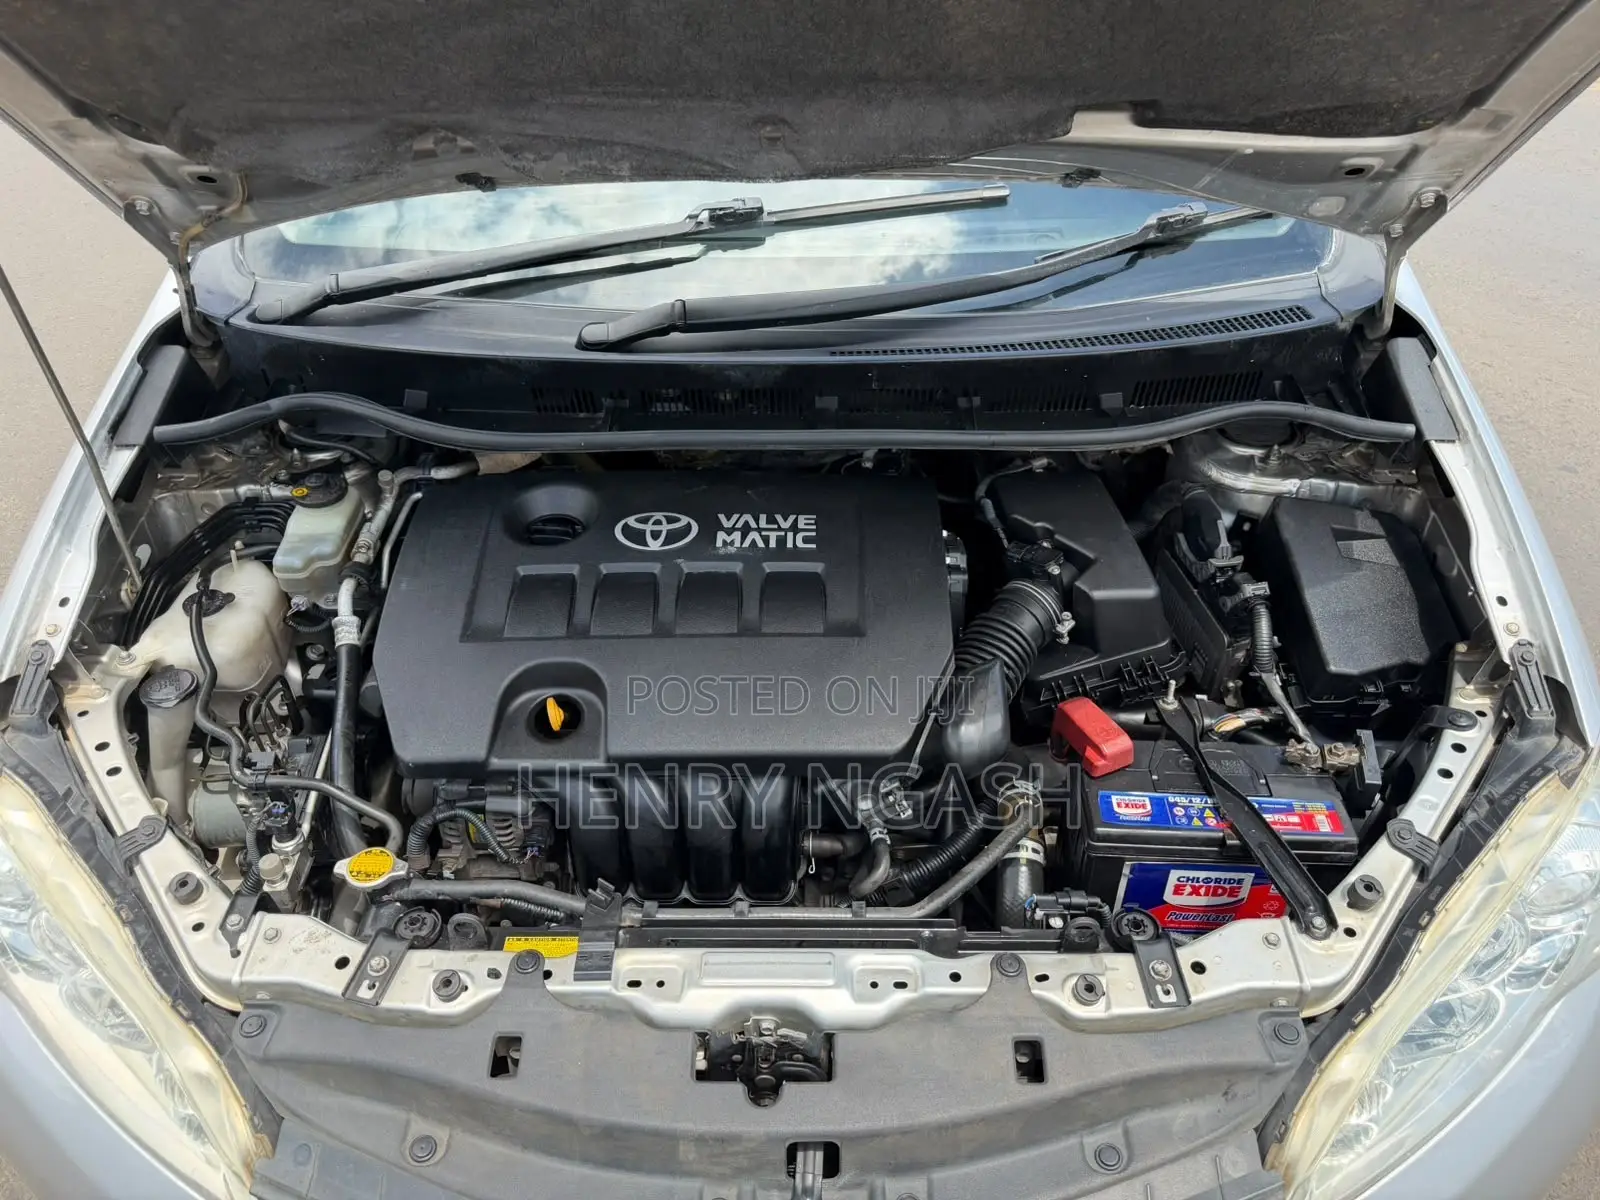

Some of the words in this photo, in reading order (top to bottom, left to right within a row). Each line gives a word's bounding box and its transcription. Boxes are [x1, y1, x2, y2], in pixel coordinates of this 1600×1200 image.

[717, 514, 816, 528] VALVE
[715, 531, 816, 548] MATIC
[1116, 802, 1148, 810] EXIDE
[1176, 875, 1245, 886] CHLORIDE
[1172, 884, 1243, 898] EXIDE
